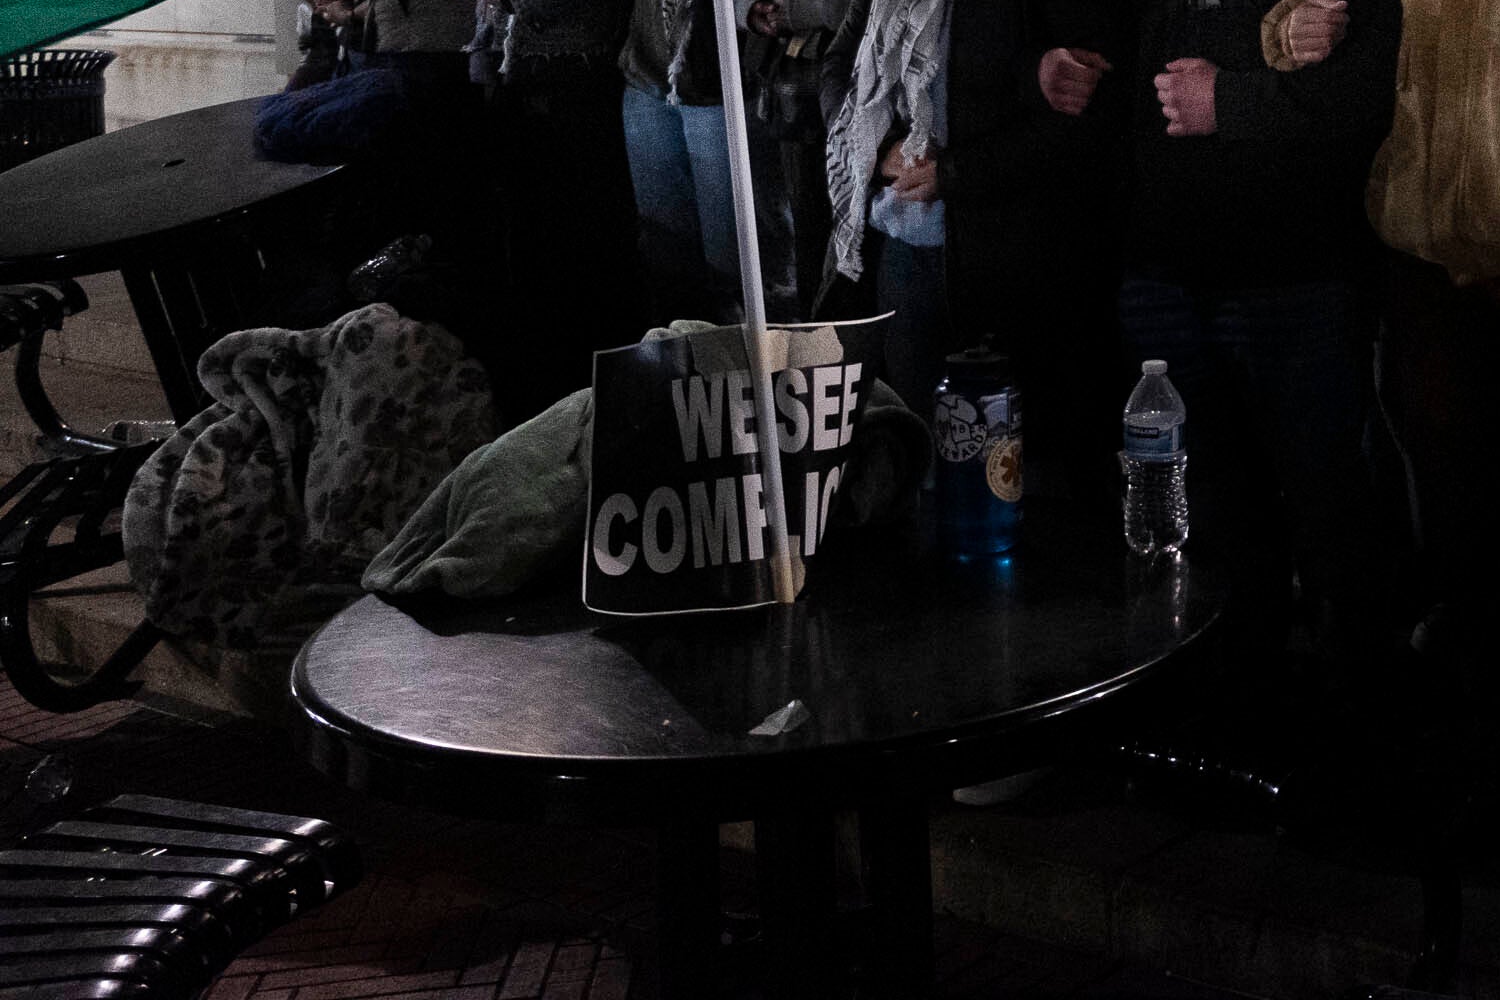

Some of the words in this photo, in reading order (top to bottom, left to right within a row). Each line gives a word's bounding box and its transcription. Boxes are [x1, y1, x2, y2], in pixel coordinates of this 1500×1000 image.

[672, 368, 760, 463] WE
[773, 362, 864, 454] SEE
[592, 461, 849, 577] COMPIC
